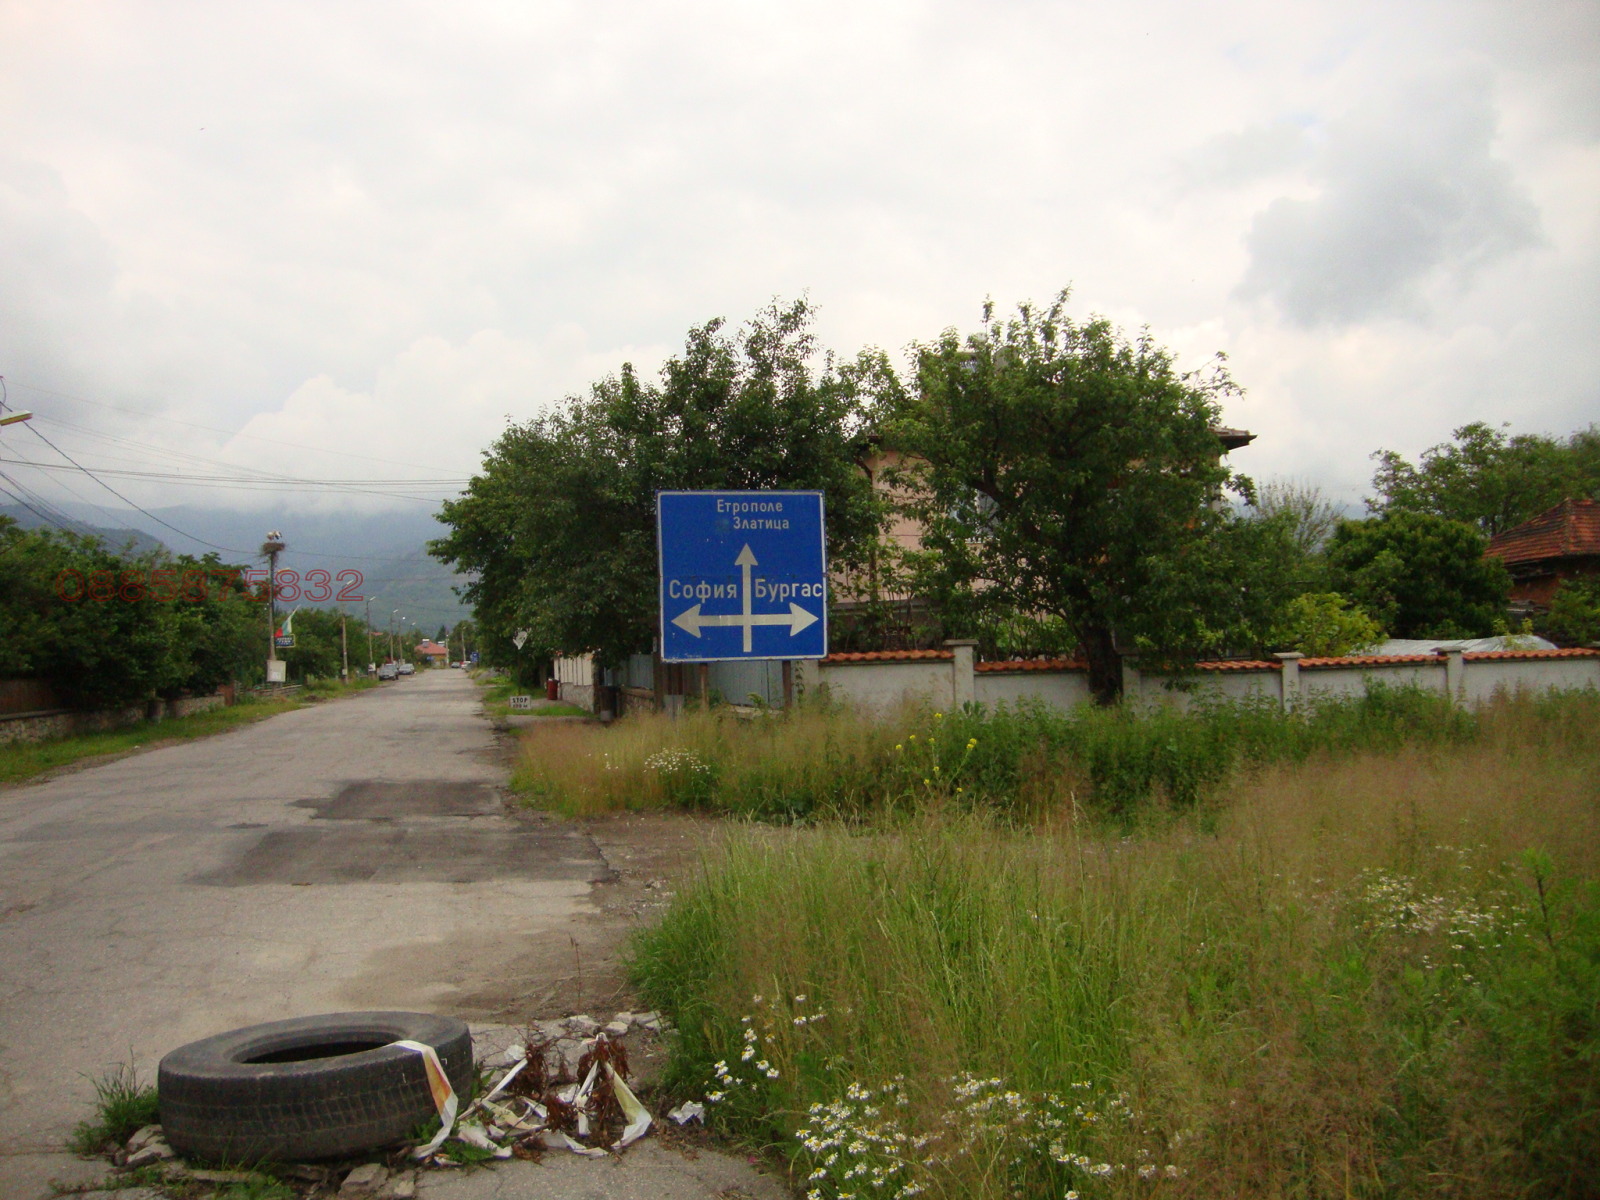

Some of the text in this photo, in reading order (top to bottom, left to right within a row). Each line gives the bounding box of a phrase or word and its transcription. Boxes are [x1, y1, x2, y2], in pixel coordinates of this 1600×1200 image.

[717, 499, 783, 515] Етрополе
[733, 517, 789, 530] Златица
[669, 580, 737, 603] София
[755, 579, 823, 602] Бургас
